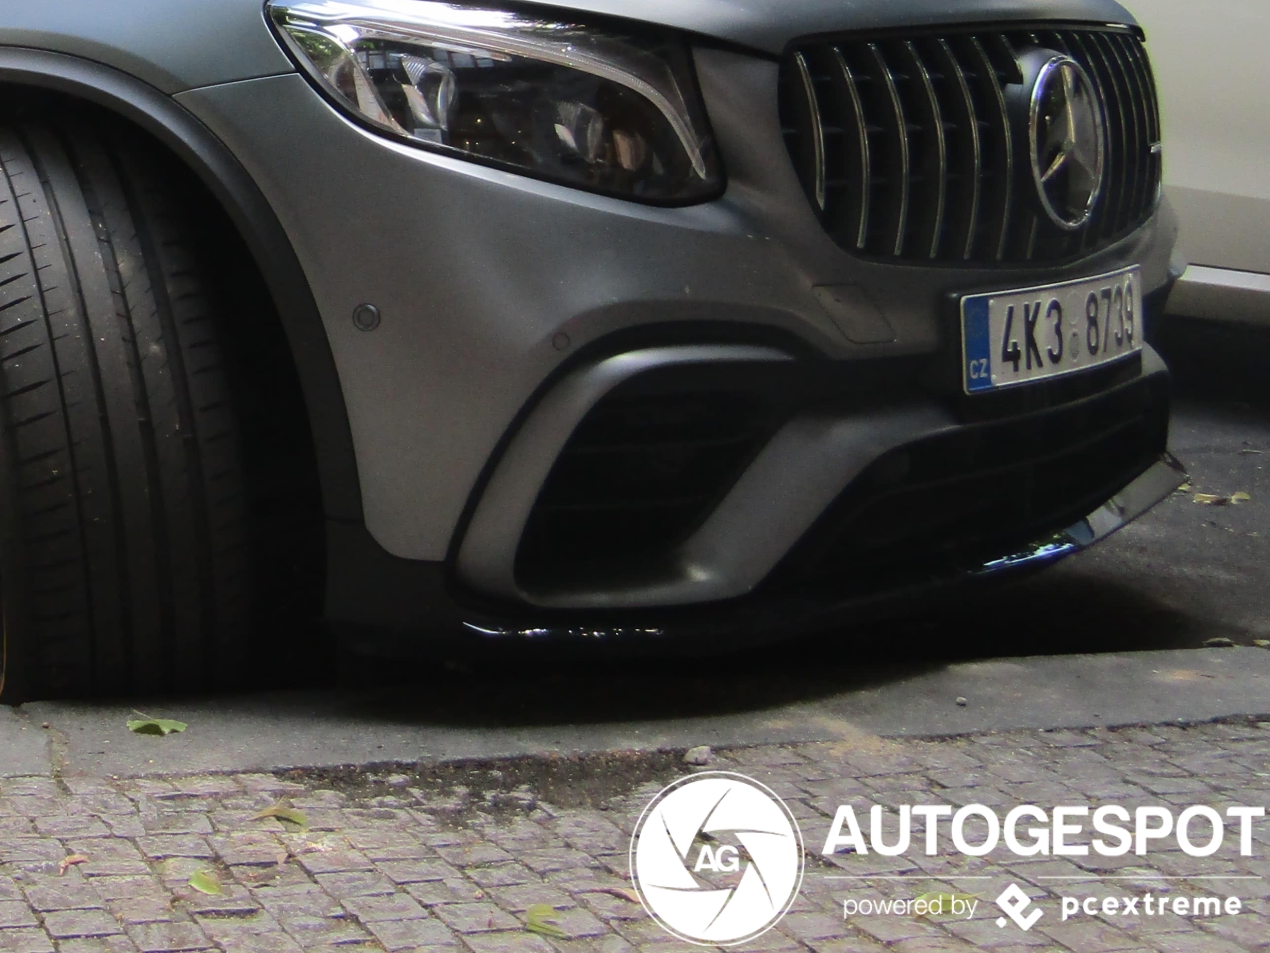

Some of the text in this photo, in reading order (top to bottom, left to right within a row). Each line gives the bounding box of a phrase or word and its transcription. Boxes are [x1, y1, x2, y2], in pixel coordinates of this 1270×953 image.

[1001, 279, 1134, 373] 4K3 8739
[969, 358, 988, 380] CZ
